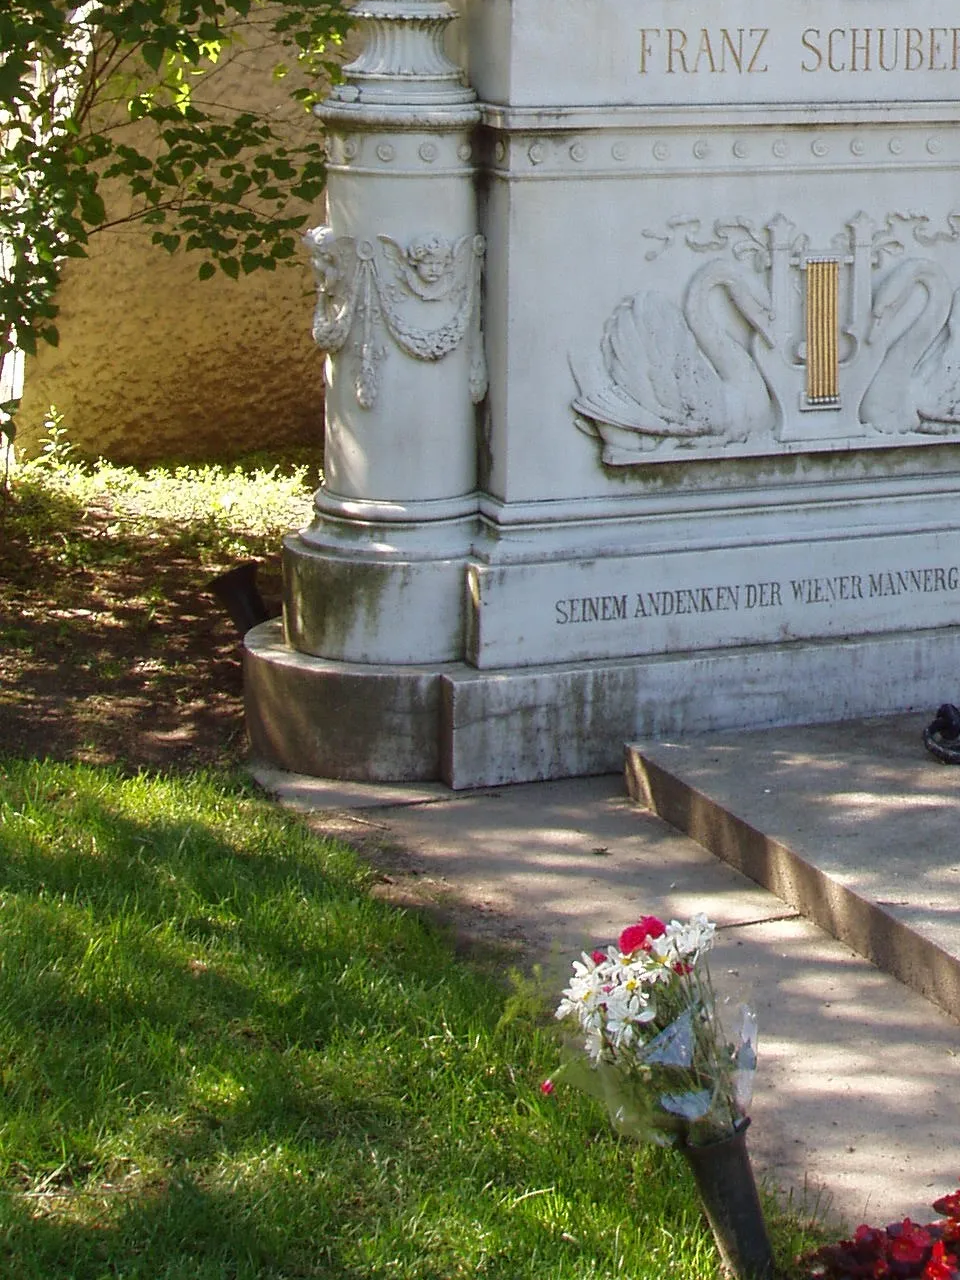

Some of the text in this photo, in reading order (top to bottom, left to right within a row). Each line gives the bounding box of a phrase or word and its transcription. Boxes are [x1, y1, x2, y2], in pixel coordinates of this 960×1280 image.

[638, 28, 770, 74] FRANZ
[555, 593, 628, 625] SEINEM
[634, 586, 740, 618] ANDENKEN
[745, 581, 783, 608] DER
[790, 575, 864, 604] WIENER
